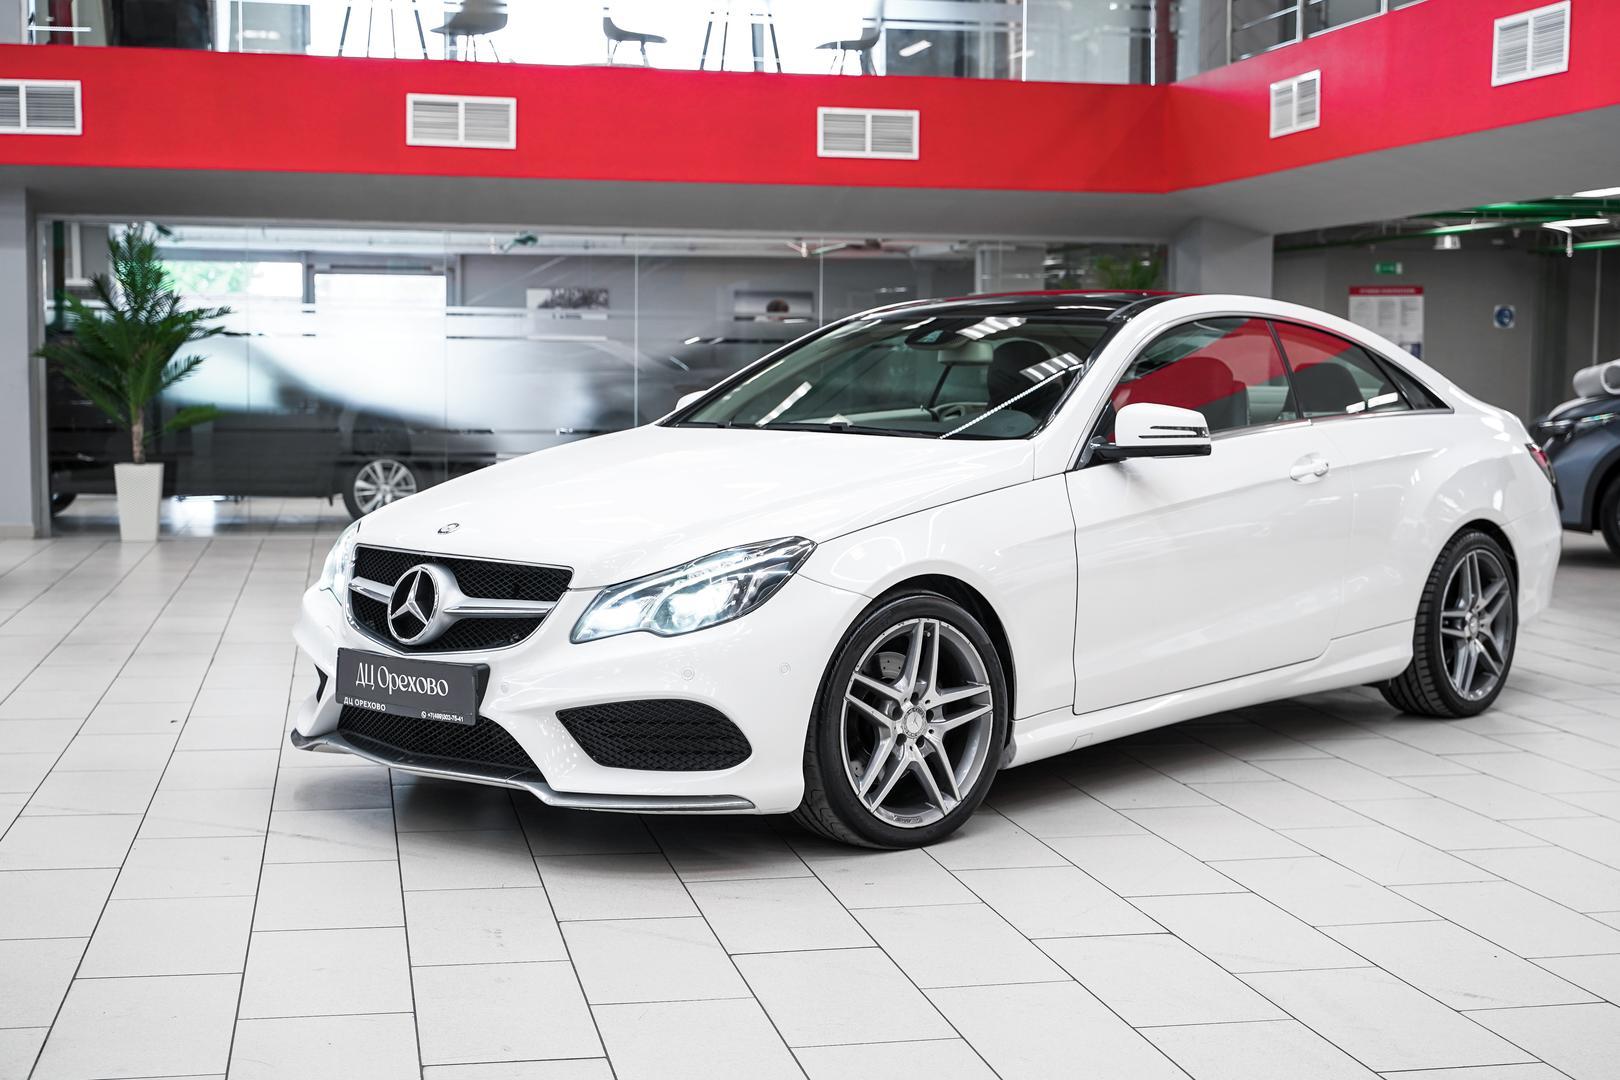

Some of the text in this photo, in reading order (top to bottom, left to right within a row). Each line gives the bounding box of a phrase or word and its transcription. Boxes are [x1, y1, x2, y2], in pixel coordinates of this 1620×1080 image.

[355, 662, 449, 696] ДЦ Орехово
[343, 696, 386, 711] ДЦ ОРЕХОВО
